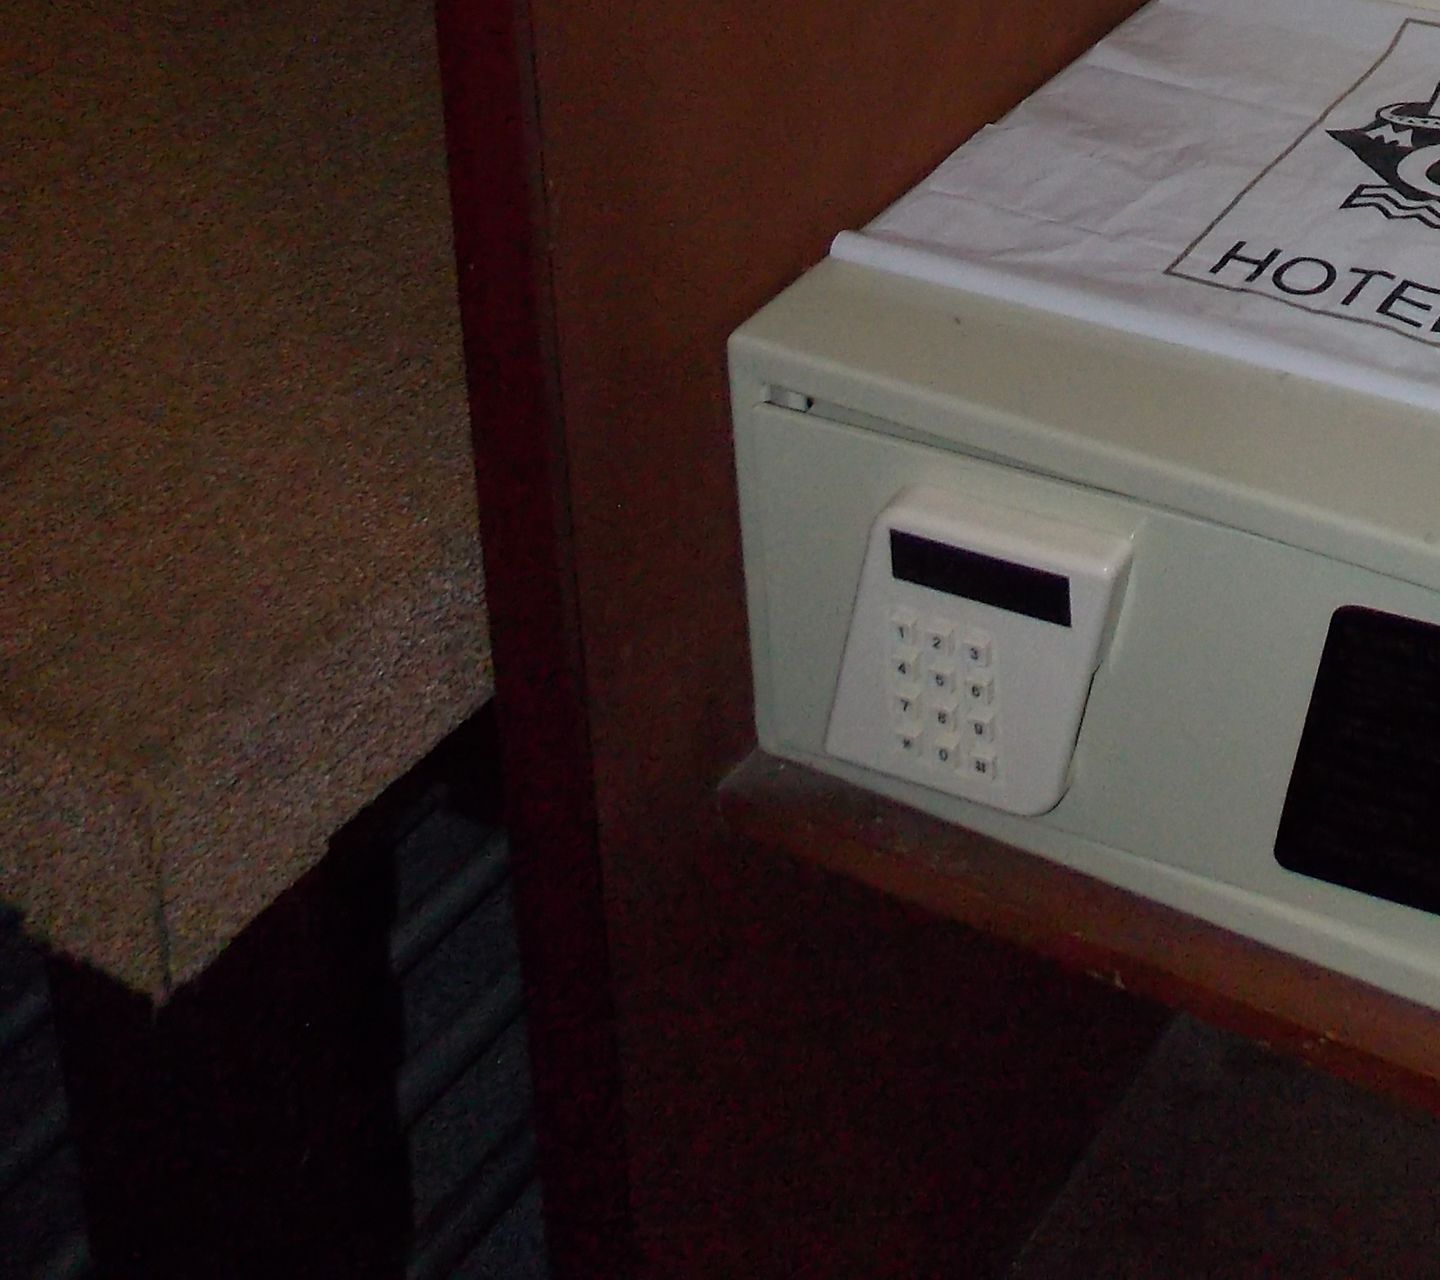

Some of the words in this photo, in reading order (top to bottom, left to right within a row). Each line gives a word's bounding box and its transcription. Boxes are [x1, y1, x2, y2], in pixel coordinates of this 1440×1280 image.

[932, 636, 941, 649] 2
[970, 647, 978, 660] 3
[898, 662, 906, 675] 4
[935, 674, 944, 687] 5
[971, 685, 980, 698] 6
[900, 698, 909, 712] 7
[938, 711, 947, 725] 8
[974, 722, 983, 736] 9
[938, 748, 948, 762] 0
